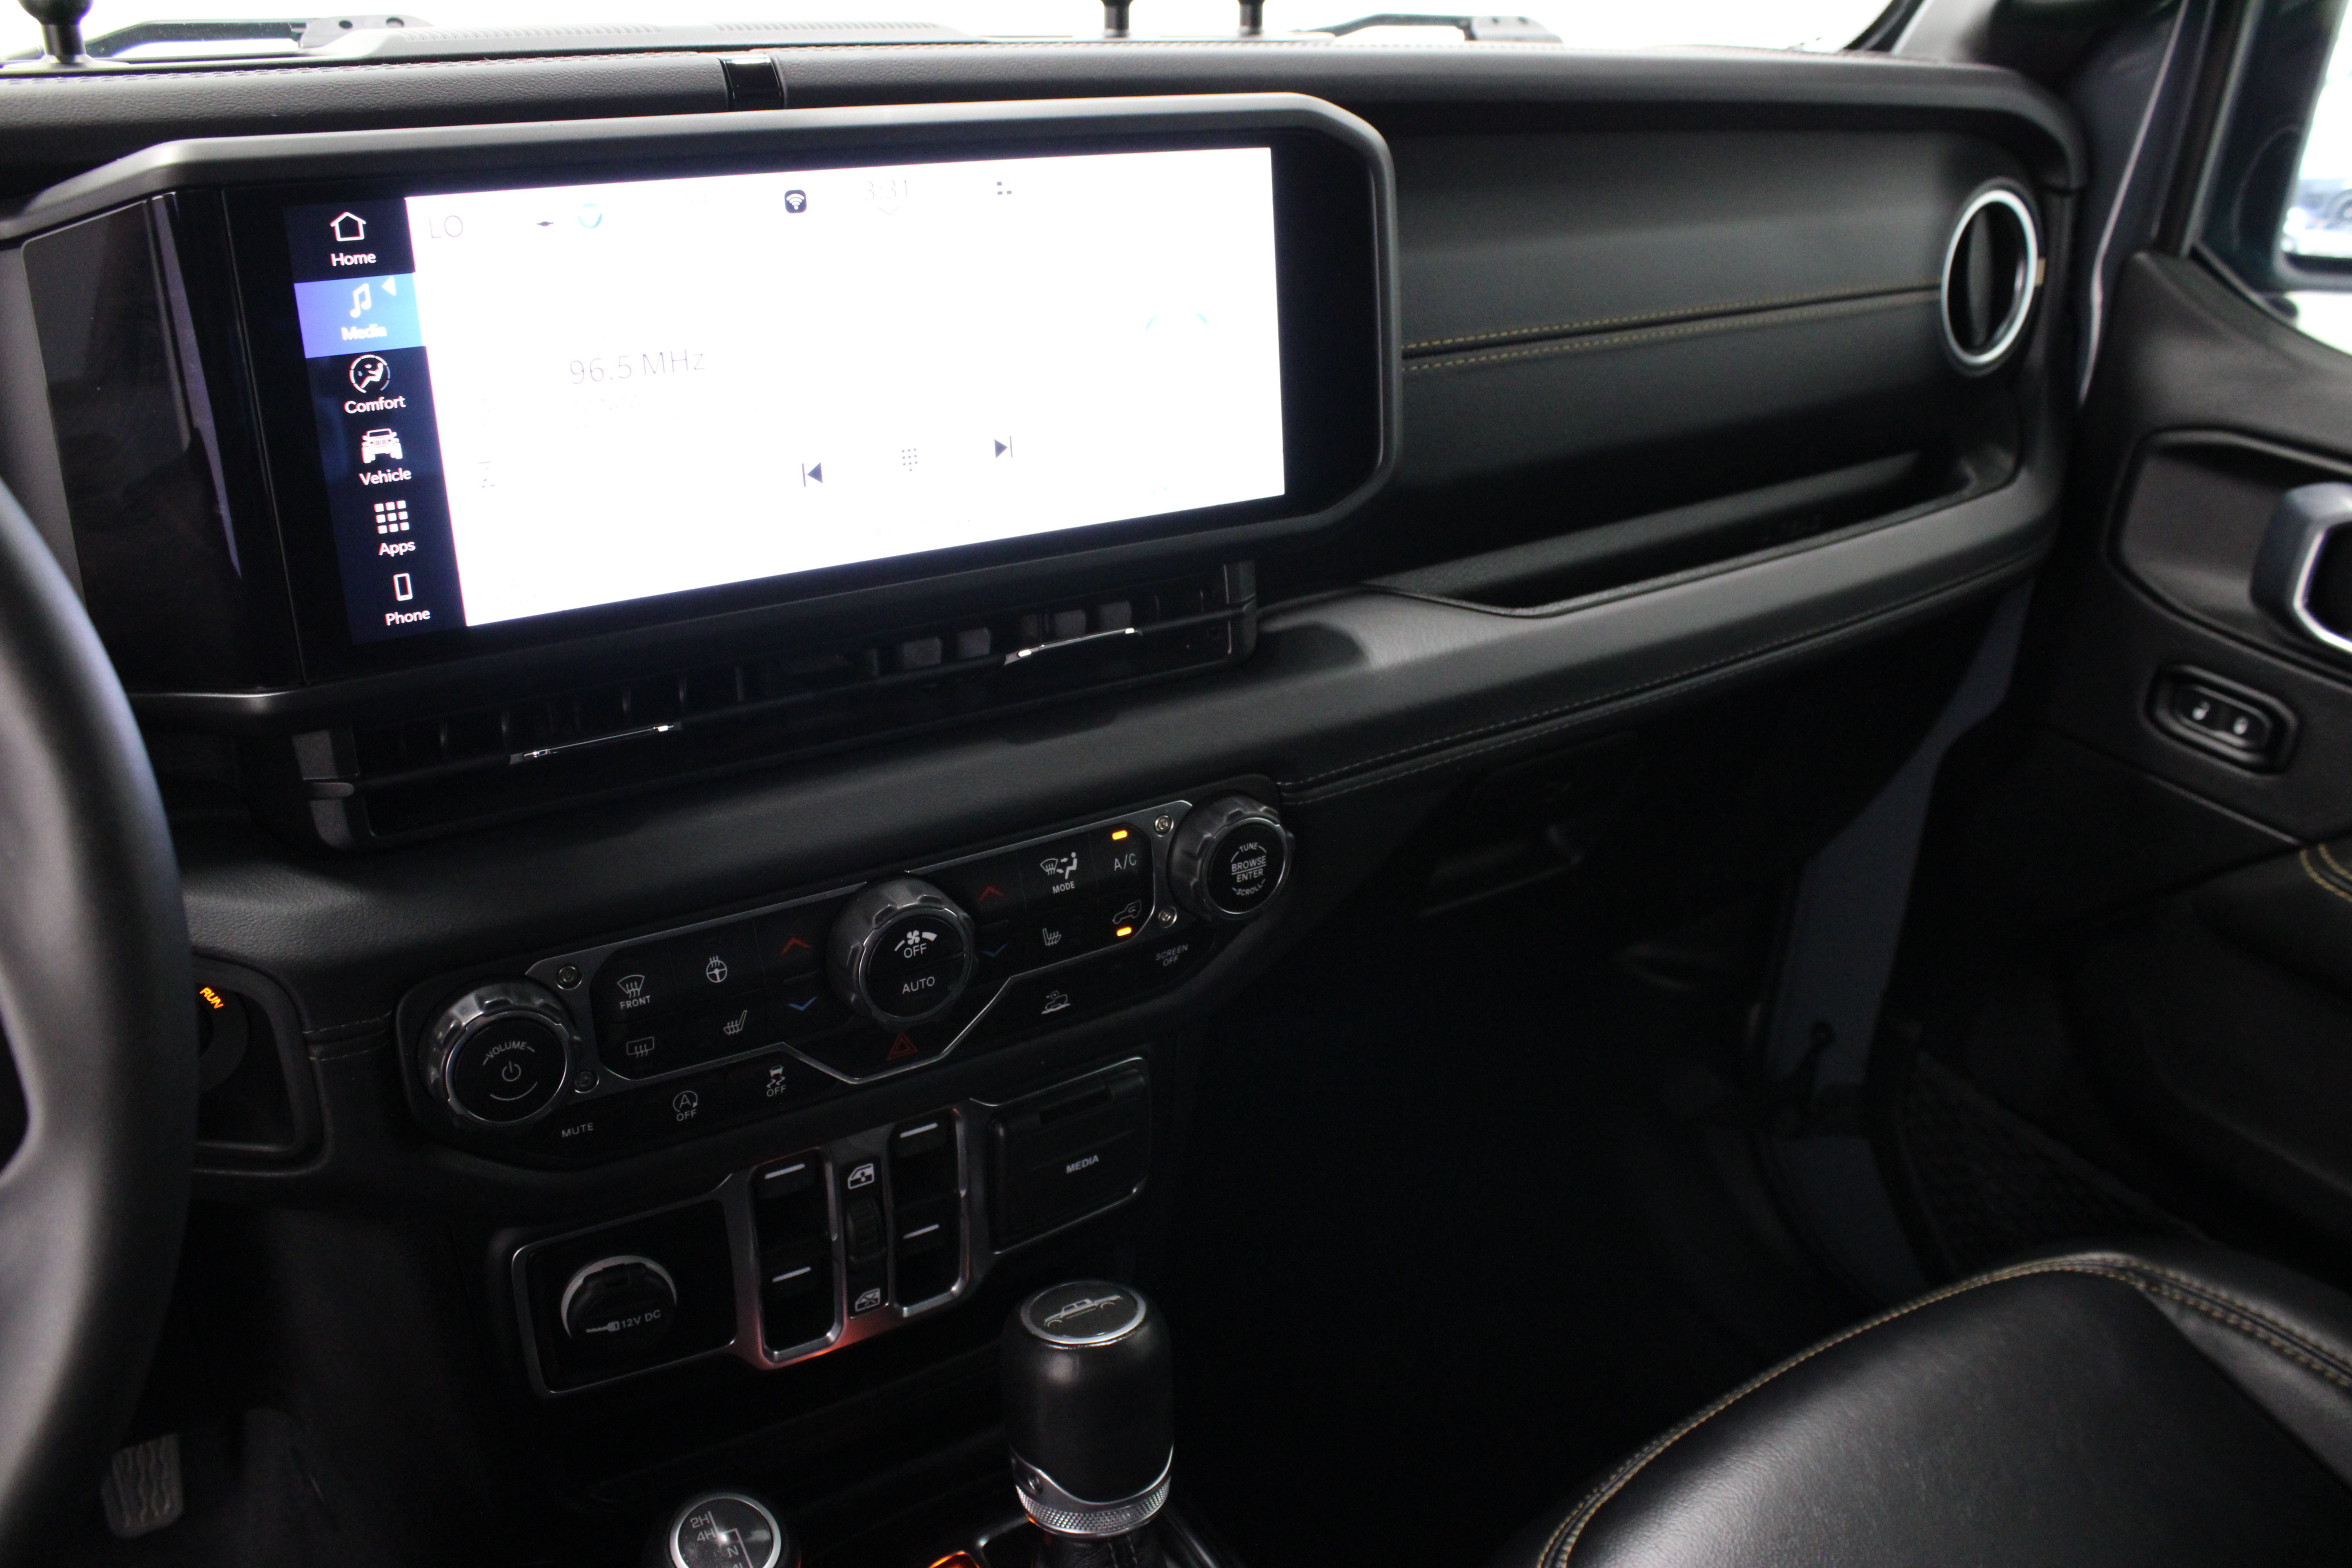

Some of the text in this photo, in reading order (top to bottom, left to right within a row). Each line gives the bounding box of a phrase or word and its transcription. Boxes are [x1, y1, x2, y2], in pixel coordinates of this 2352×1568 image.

[428, 215, 463, 238] LO
[330, 252, 377, 267] Home
[341, 324, 387, 341] Media
[570, 349, 706, 385] 96.5 MHz
[344, 395, 407, 414] Comfort
[359, 468, 412, 486] Vehicle
[378, 541, 416, 557] Apps
[385, 610, 431, 626] Phone
[1239, 842, 1258, 853] TUNE
[1114, 853, 1137, 871] A/C
[1231, 855, 1267, 872] BROWSE
[1236, 869, 1263, 883] ENTER
[1052, 881, 1075, 894] MODE
[1236, 883, 1263, 896] SCROLL
[903, 943, 927, 959] OFF
[1156, 944, 1189, 961] SCREEN
[1163, 955, 1179, 967] OFF
[902, 976, 935, 994] AUTO
[199, 987, 224, 1009] RUN
[619, 995, 651, 1010] FRONT
[486, 1041, 528, 1059] VOLUME
[766, 1085, 786, 1097] OFF
[676, 1109, 697, 1122] OFF
[561, 1123, 594, 1138] MUTE
[1066, 1155, 1099, 1174] MEDIA
[621, 1310, 661, 1328] 12V DC
[690, 1514, 710, 1528] 2H
[697, 1528, 716, 1541] 4H
[727, 1545, 739, 1557] N
